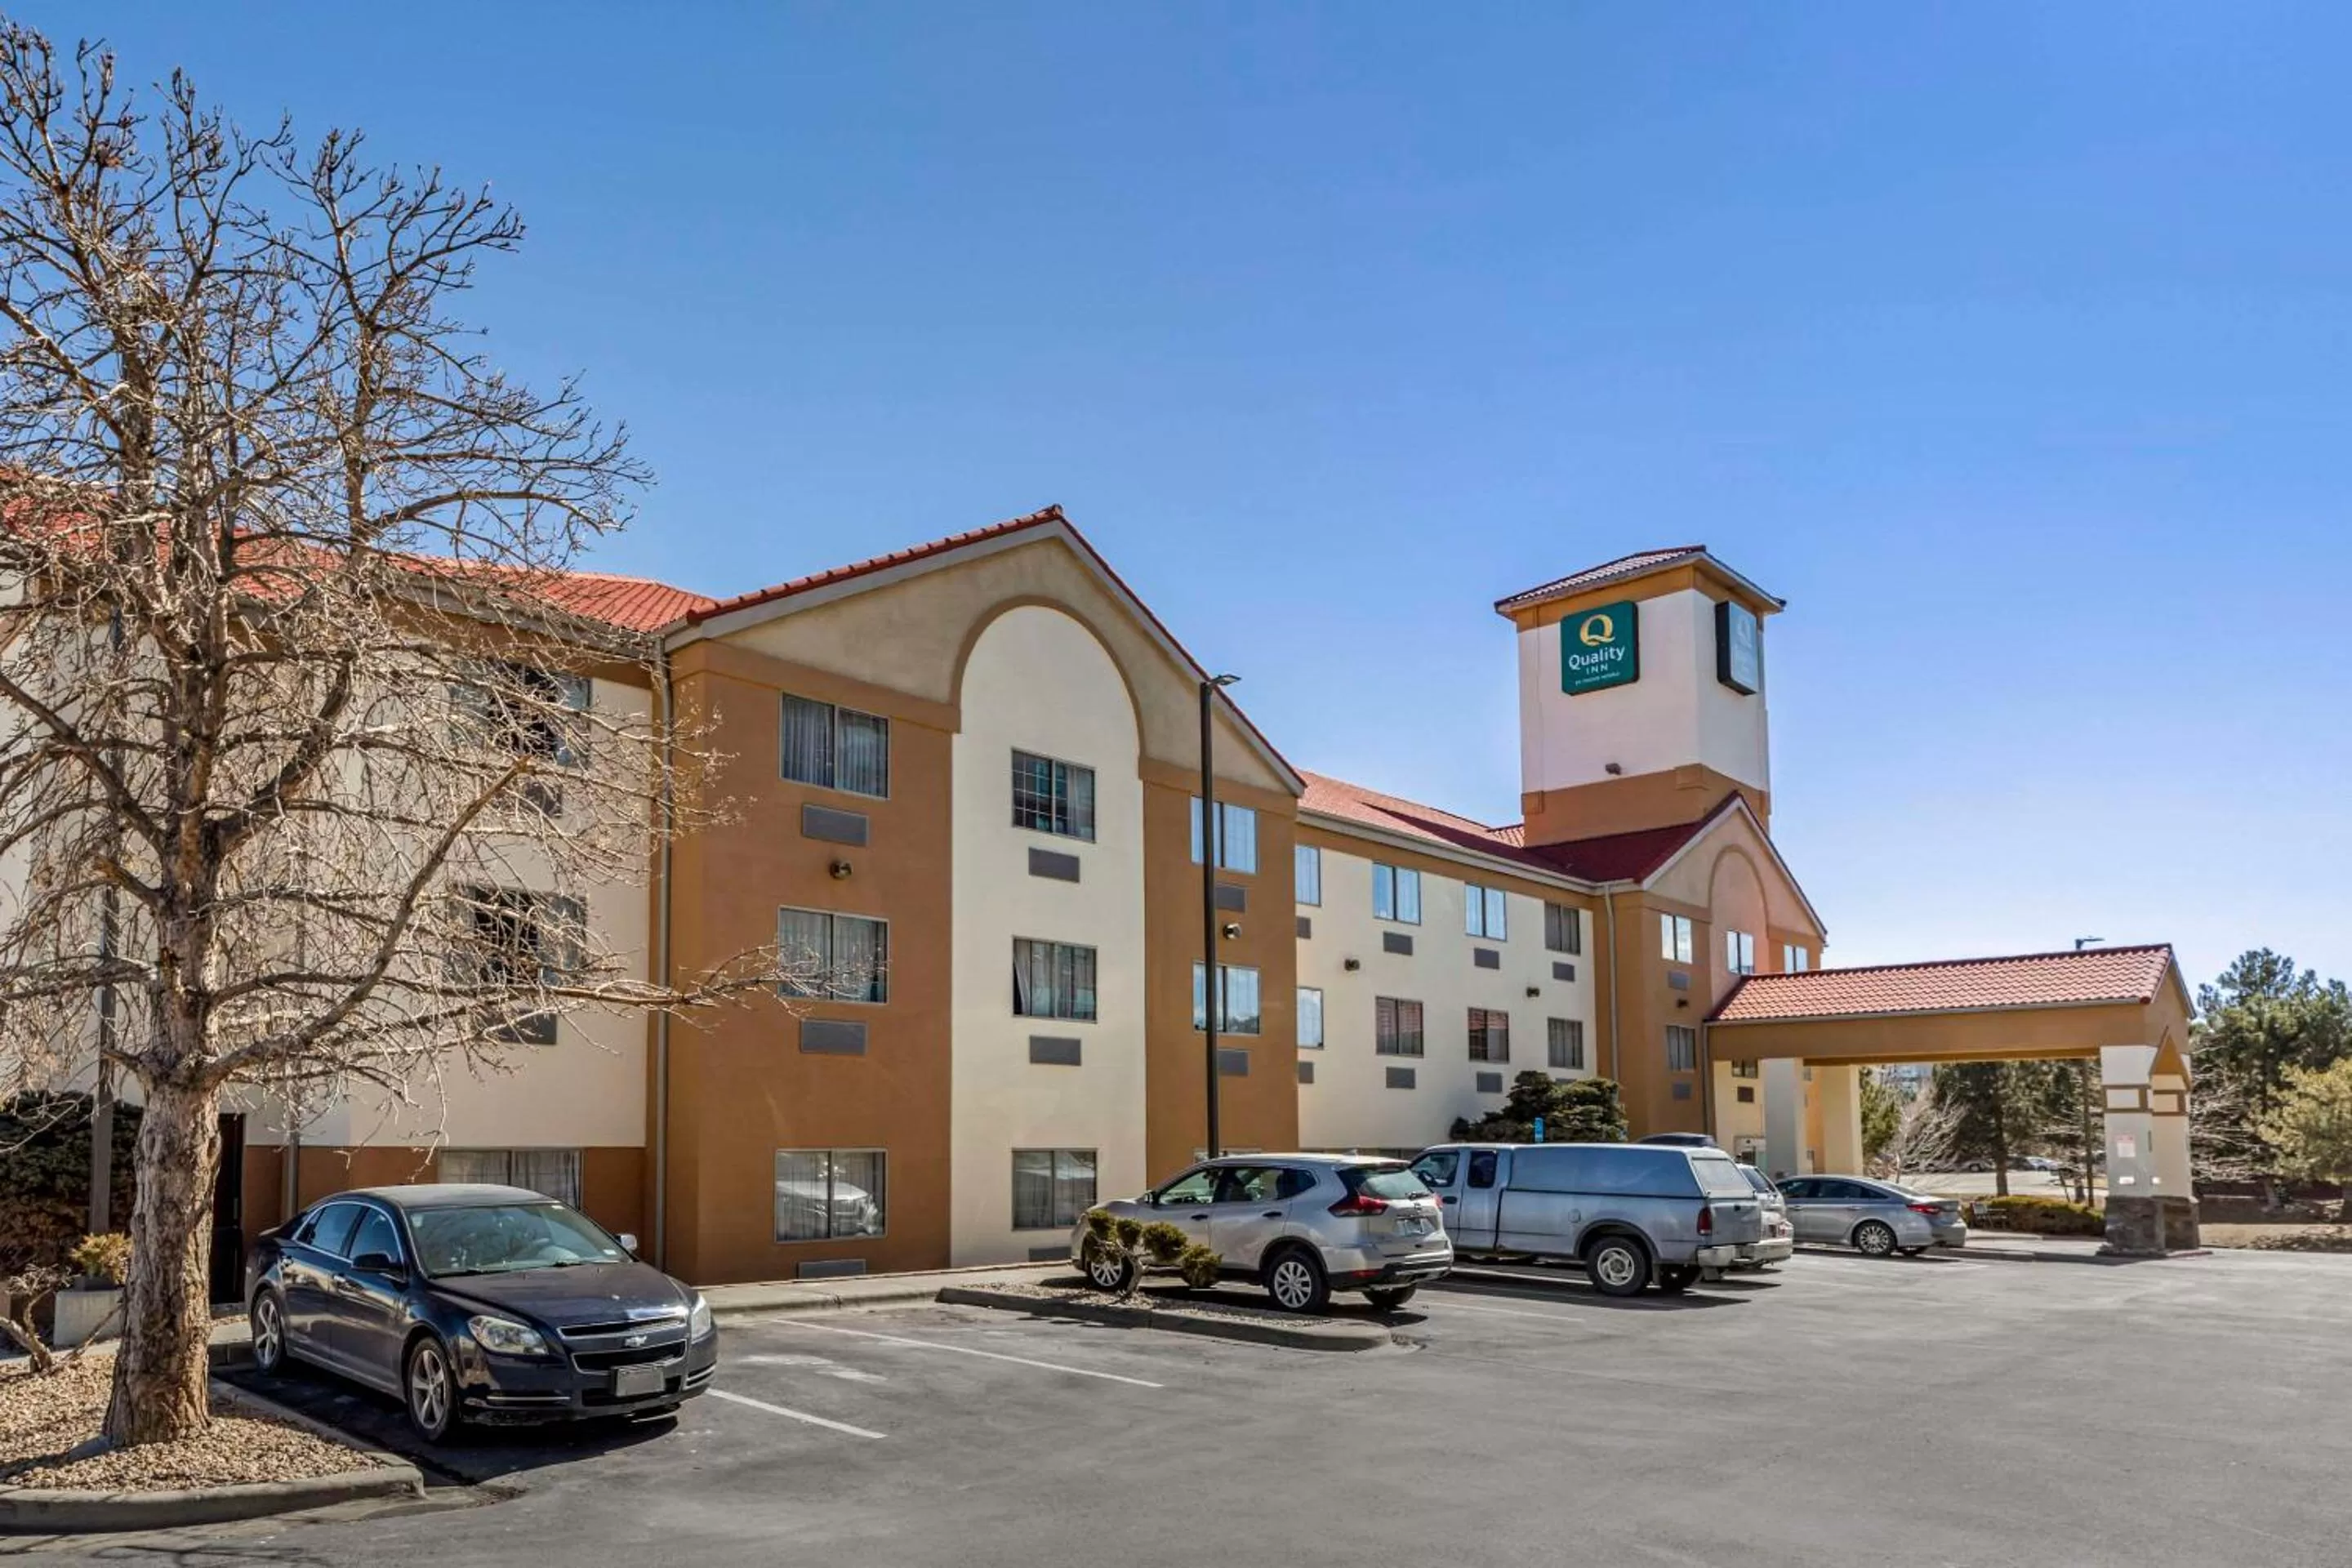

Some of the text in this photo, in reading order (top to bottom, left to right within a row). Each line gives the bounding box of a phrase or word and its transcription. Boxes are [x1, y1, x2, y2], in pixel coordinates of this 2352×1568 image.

[1580, 614, 1615, 647] Q
[1569, 646, 1625, 670] Quality
[1586, 662, 1608, 675] INN
